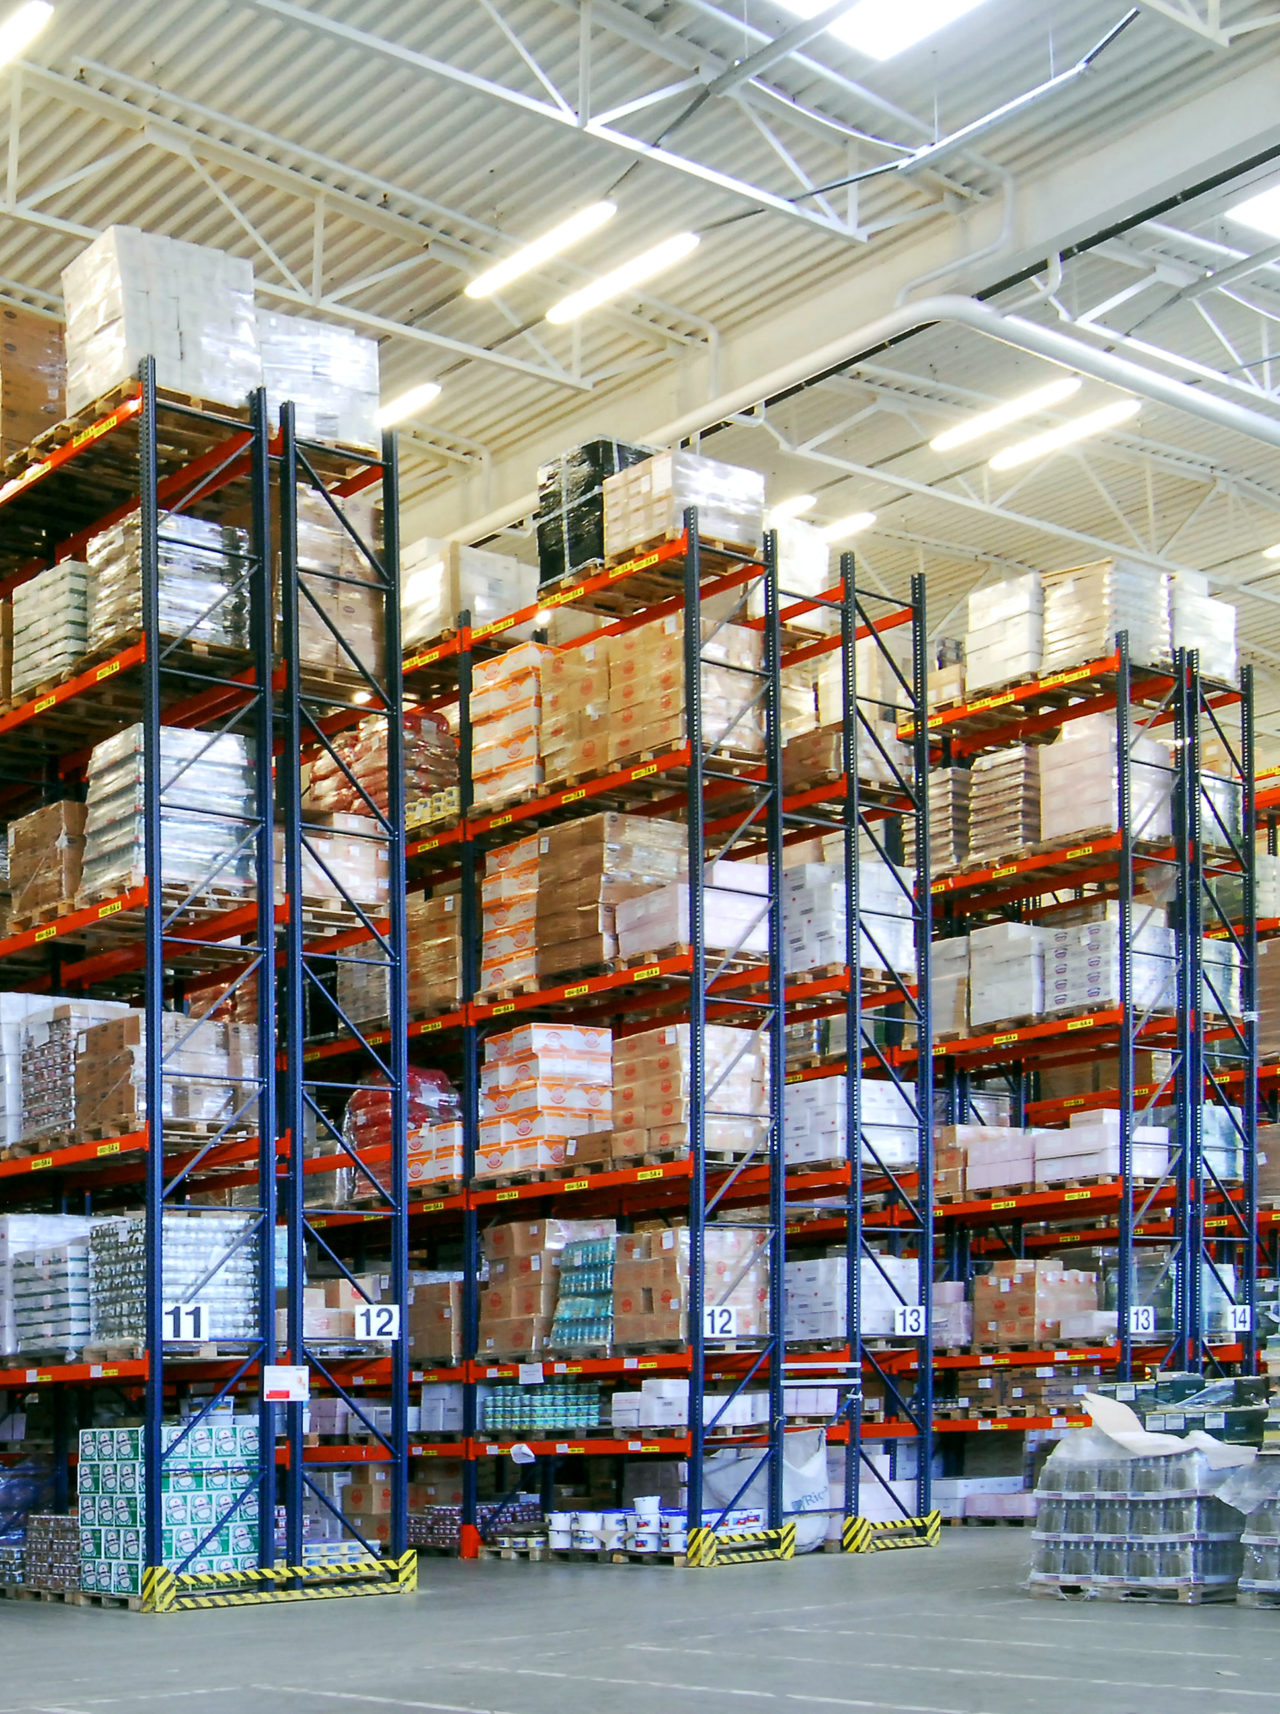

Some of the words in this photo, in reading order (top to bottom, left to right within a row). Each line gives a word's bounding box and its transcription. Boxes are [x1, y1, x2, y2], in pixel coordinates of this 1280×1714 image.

[164, 1305, 201, 1339] 11
[360, 1307, 393, 1337] 12
[706, 1309, 732, 1335] 12
[898, 1309, 921, 1333] 13
[1133, 1308, 1151, 1331] 13
[1231, 1307, 1247, 1328] 14
